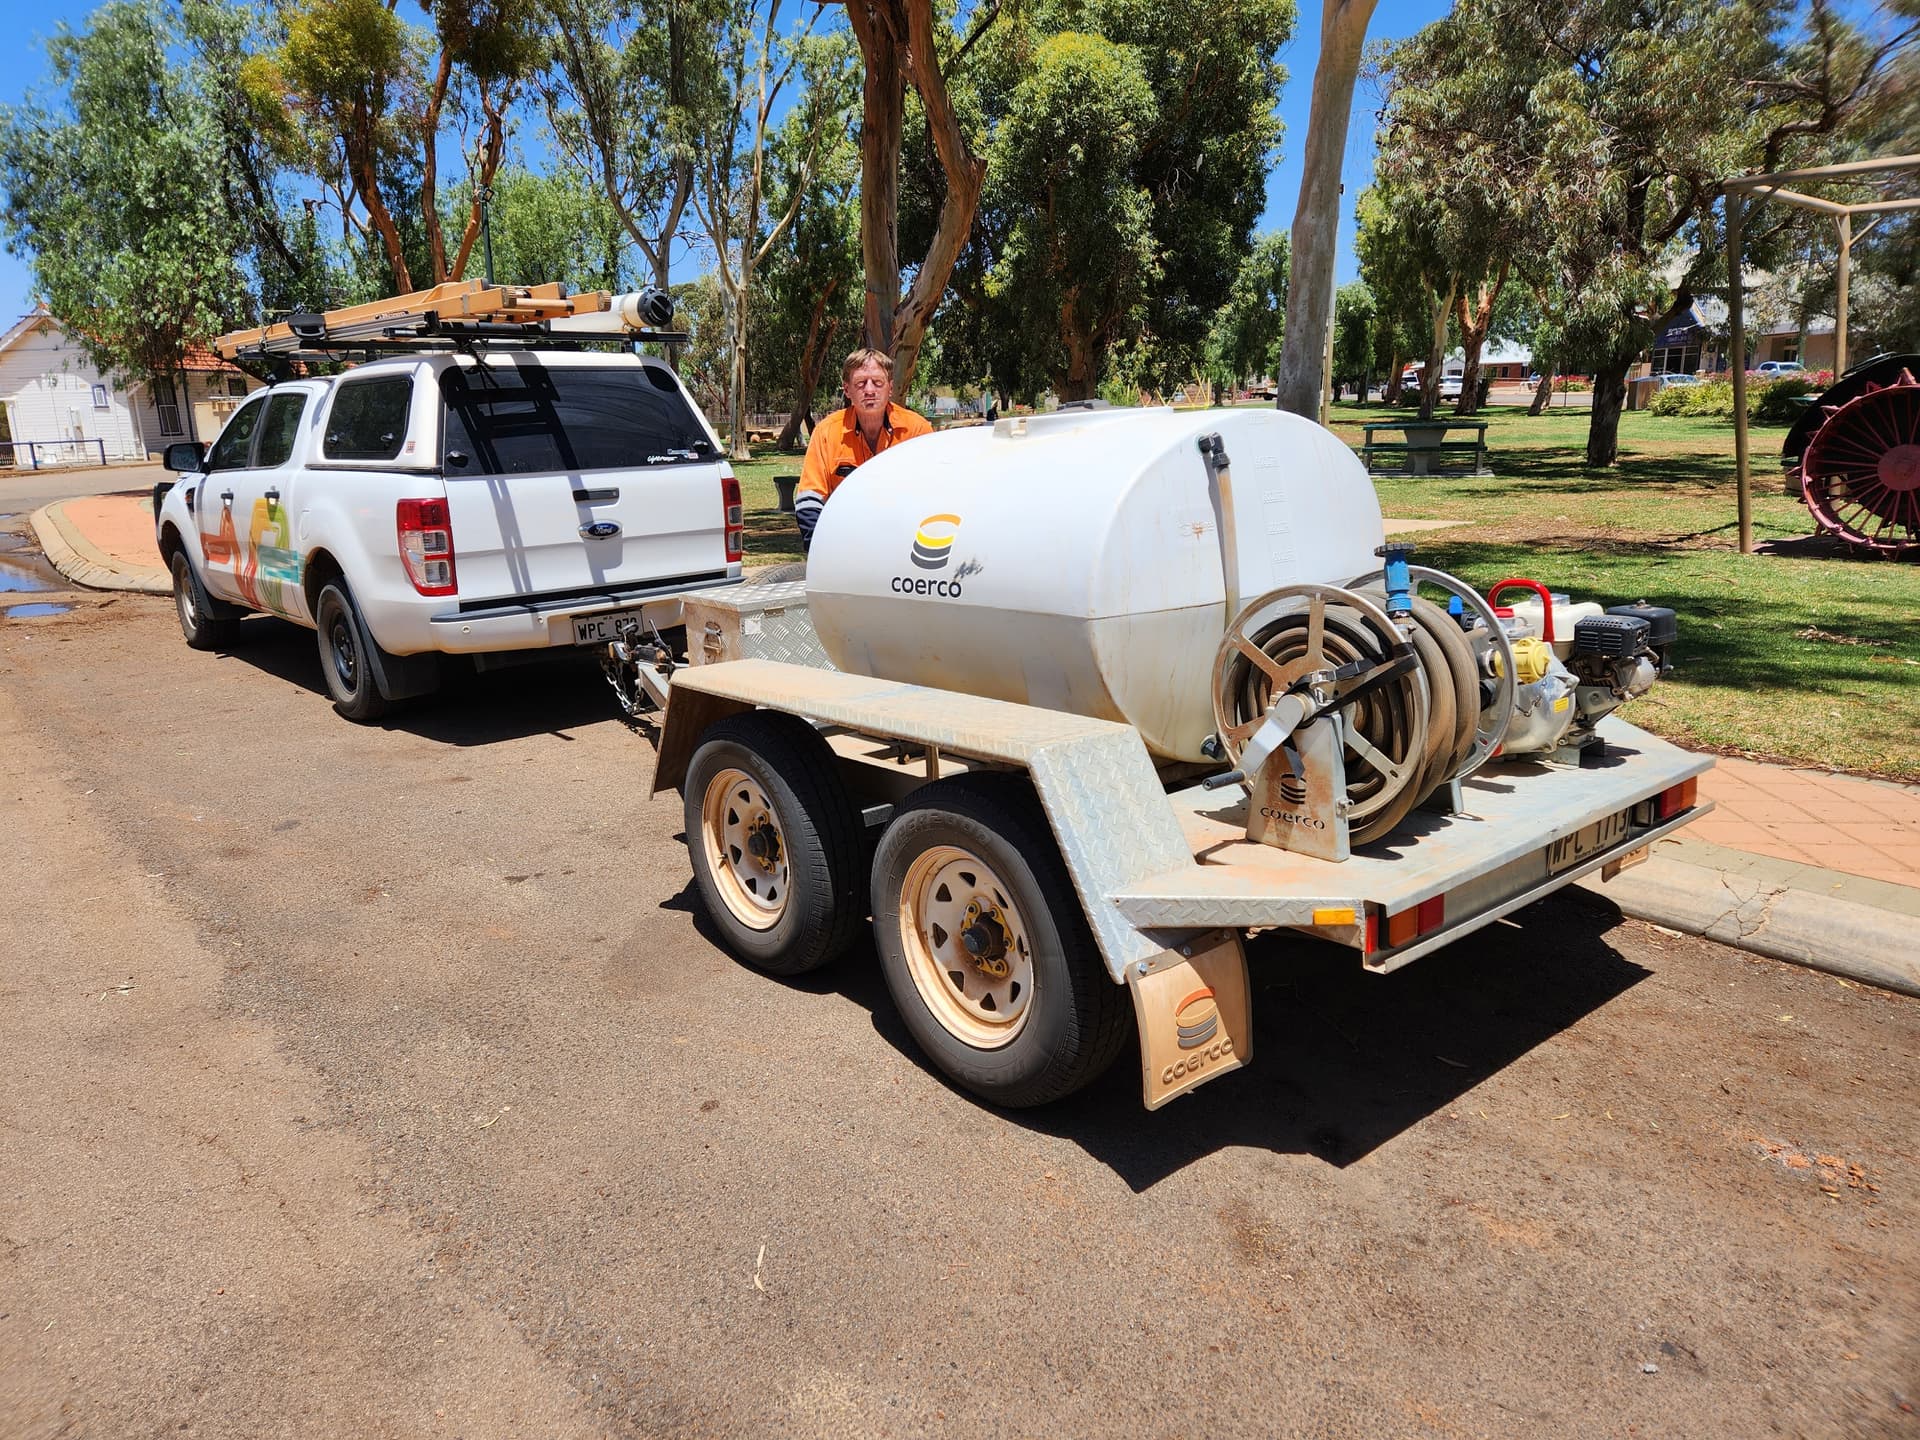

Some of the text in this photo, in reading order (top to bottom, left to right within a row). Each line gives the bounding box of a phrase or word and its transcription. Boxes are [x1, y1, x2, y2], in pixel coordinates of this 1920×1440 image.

[891, 577, 962, 598] coerco
[578, 622, 606, 641] WPC
[1260, 807, 1325, 830] coerco
[1161, 1037, 1234, 1085] coerco
